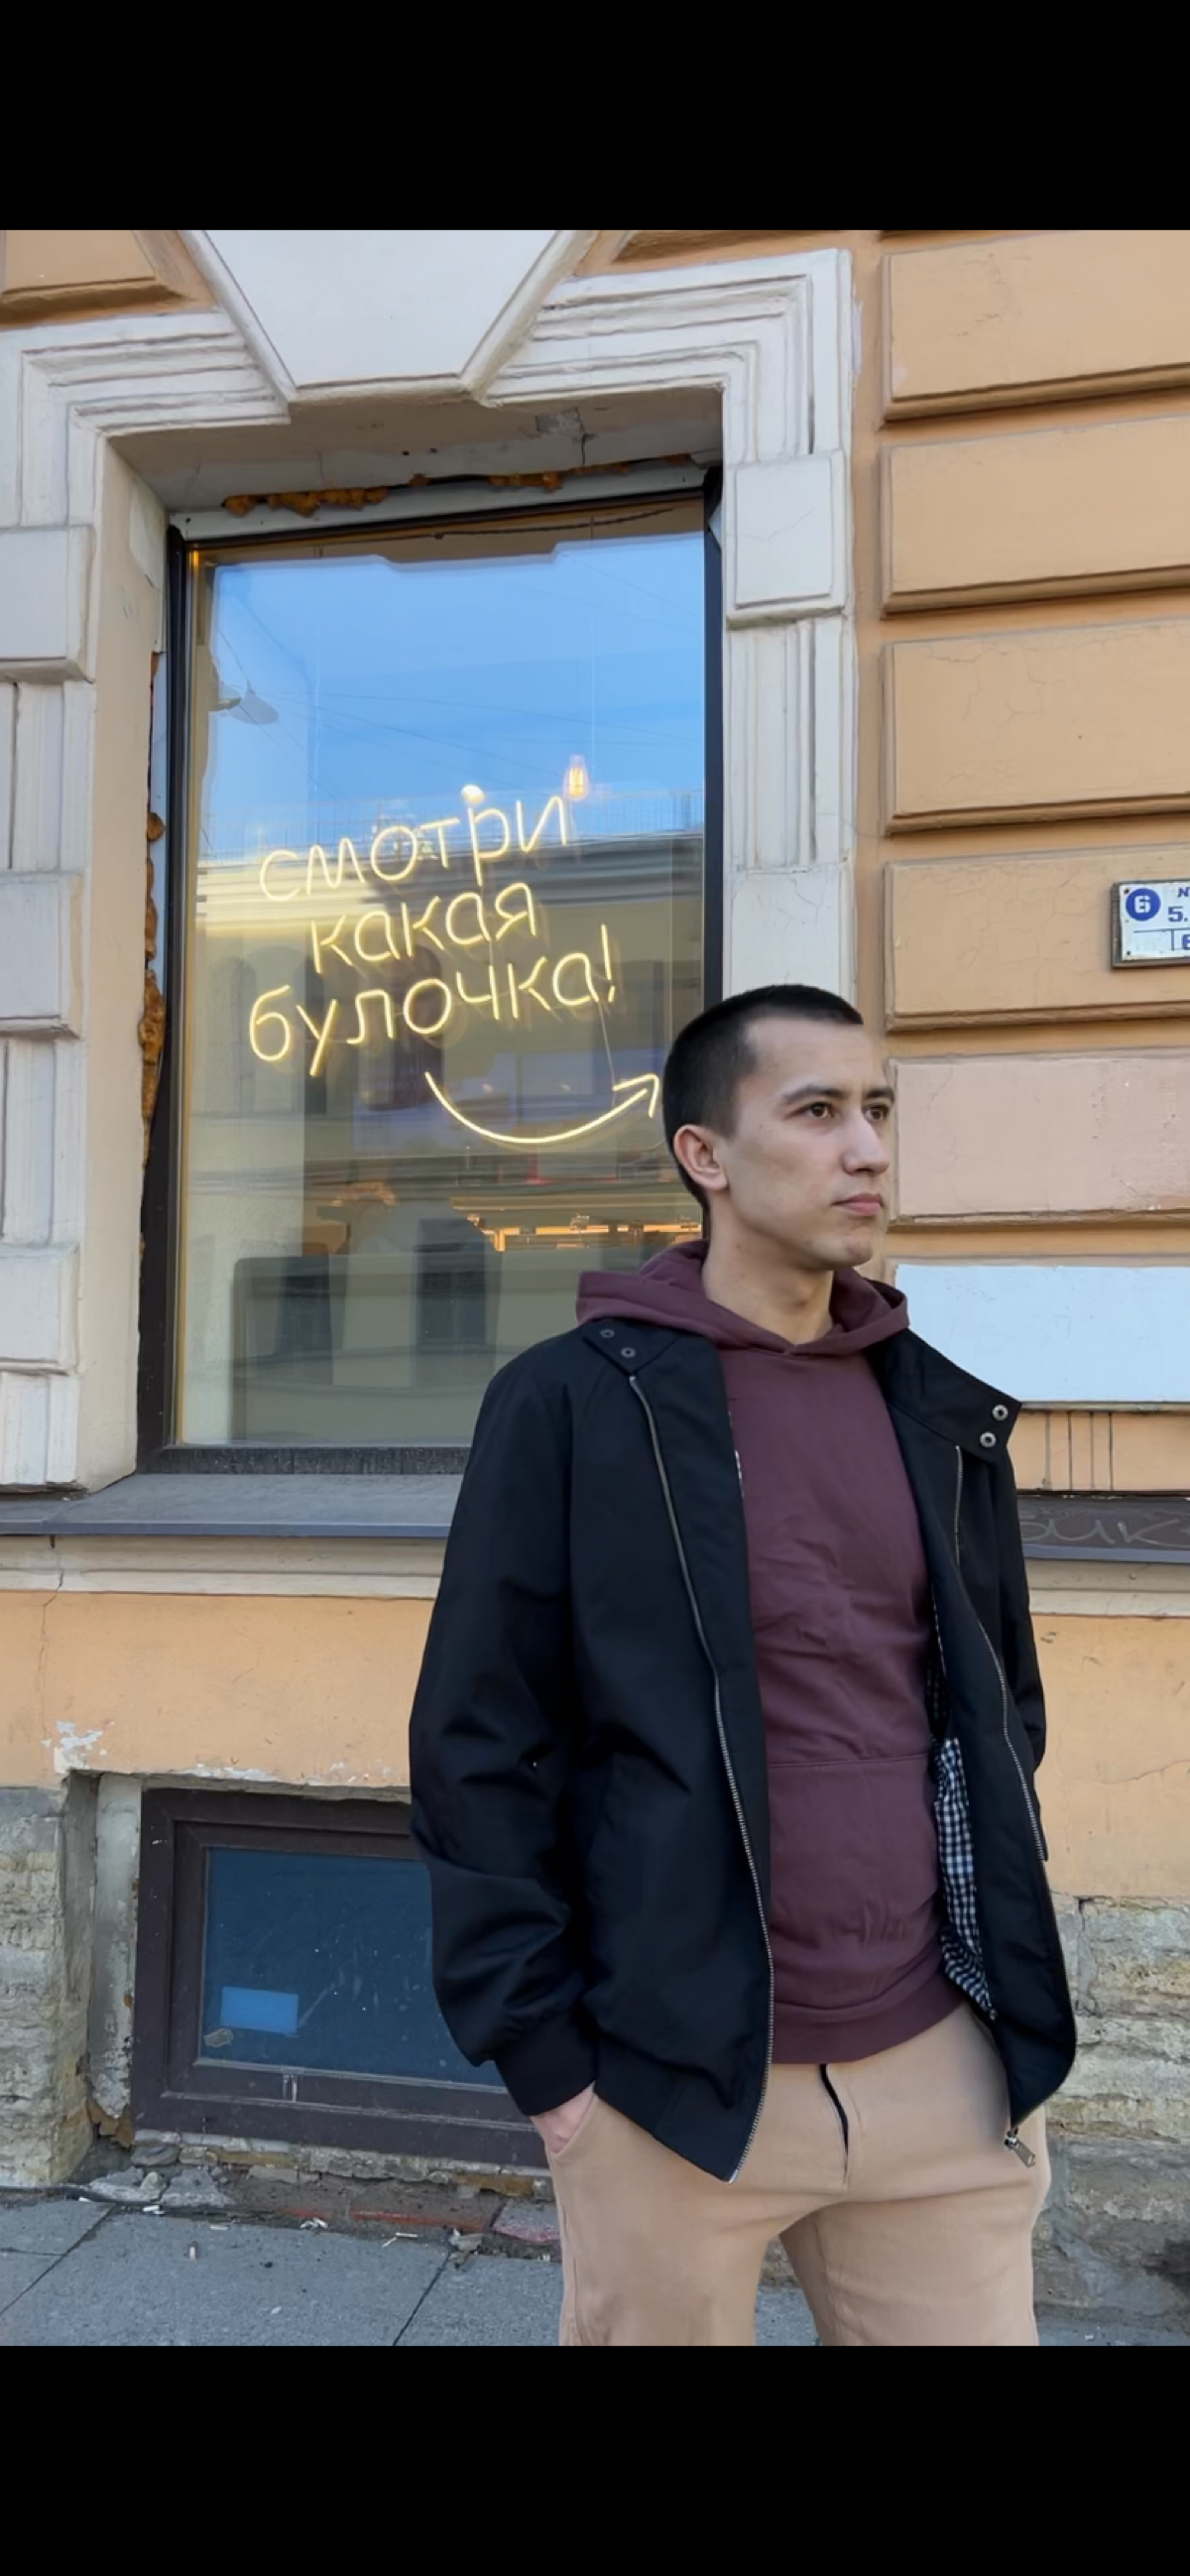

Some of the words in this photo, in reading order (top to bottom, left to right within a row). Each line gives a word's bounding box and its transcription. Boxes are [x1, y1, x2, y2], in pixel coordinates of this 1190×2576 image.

[259, 796, 568, 902] смотри
[310, 882, 536, 974] какая
[1133, 895, 1151, 914] 6
[249, 923, 616, 1076] булочка!
